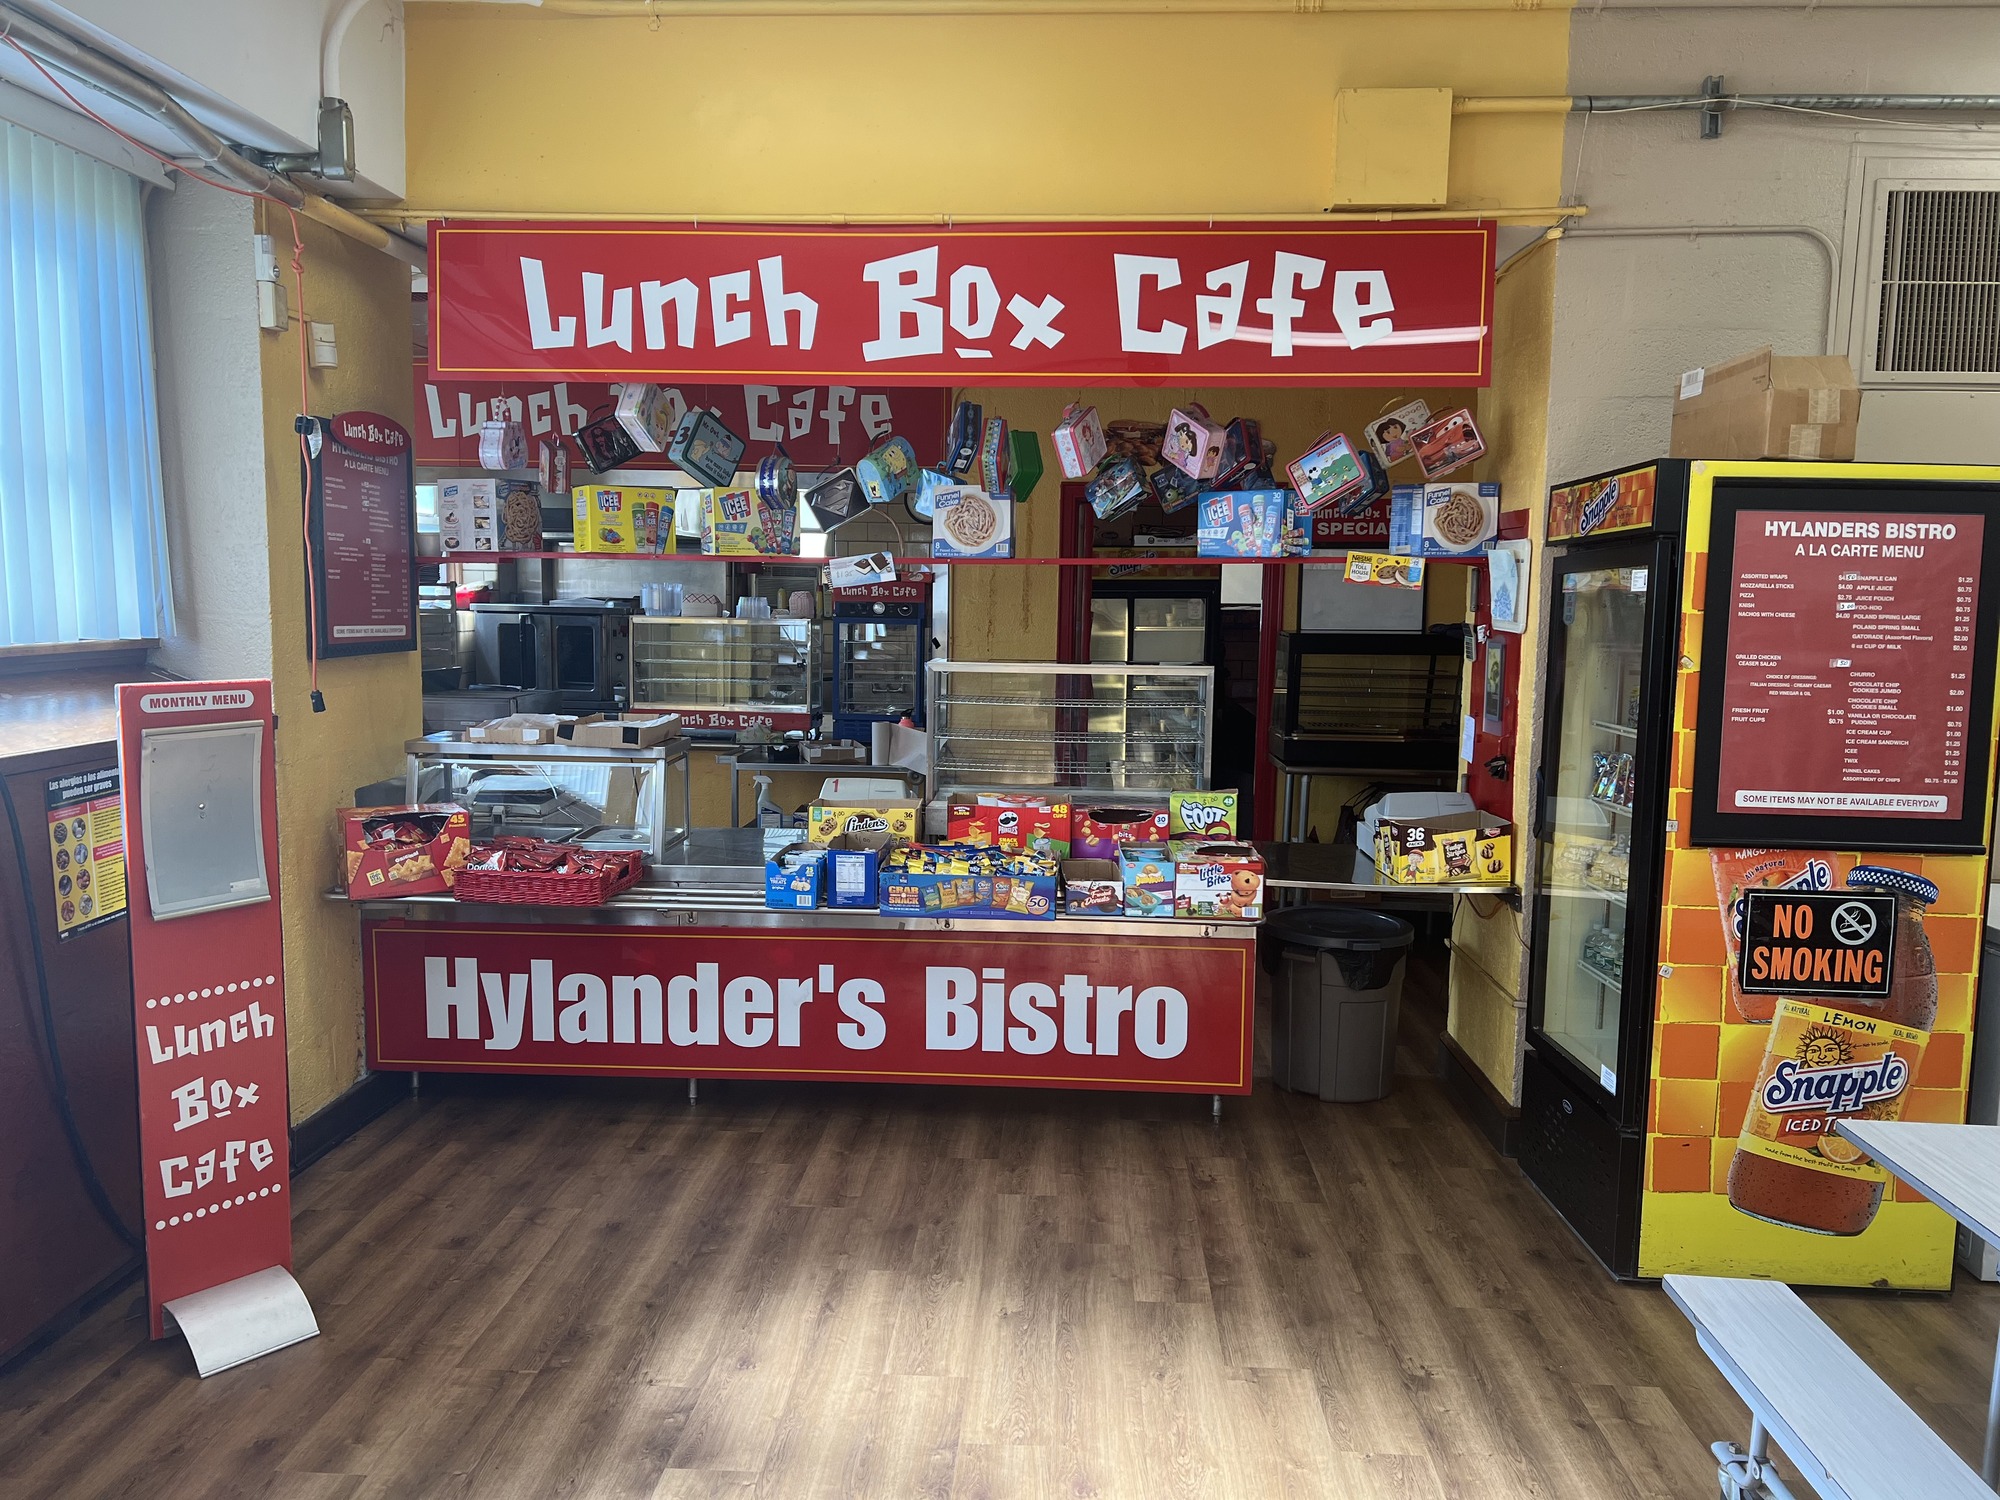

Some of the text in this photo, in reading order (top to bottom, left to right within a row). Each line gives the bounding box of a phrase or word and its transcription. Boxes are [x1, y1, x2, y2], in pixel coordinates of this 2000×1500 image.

[519, 245, 1395, 362] Lunch Box Cafe
[424, 382, 588, 439] Lunch
[743, 384, 893, 445] Cafe
[343, 420, 404, 447] Lunch Box Cafe
[674, 426, 691, 445] 3
[344, 459, 390, 476] A LA CARTE MENU
[600, 494, 620, 507] ICEE
[936, 491, 960, 502] Funnel
[1427, 488, 1451, 500] Funnel
[1429, 496, 1450, 505] Cake
[723, 495, 748, 516] ICEE
[938, 499, 959, 508] Cake
[1580, 476, 1618, 532] Snapple
[1207, 501, 1229, 521] ICEE
[1317, 522, 1389, 535] SPECIA
[1764, 520, 1956, 540] HYLANDERS BISTRO
[935, 541, 940, 549] 8
[1424, 540, 1429, 548] 8
[1794, 543, 1925, 559] A LA CARTE MENU
[841, 585, 917, 597] Lunch Box Cafe
[150, 693, 246, 709] MONTHLY MENU
[681, 713, 773, 727] nch Box Cafe
[49, 781, 59, 791] Las
[831, 778, 840, 793] 1
[1223, 797, 1234, 806] 48
[1742, 794, 1940, 808] SOME ITEMS MAY NOT BE AVAILABLE EVERYDAY
[903, 811, 914, 819] 36
[1052, 804, 1068, 814] 48
[450, 814, 465, 824] 45
[844, 815, 889, 833] Linden's
[1156, 816, 1167, 824] 30
[1180, 805, 1229, 832] FOOT
[997, 825, 1019, 836] PRINGLES
[1118, 831, 1133, 839] bits
[1406, 827, 1426, 842] 36
[1445, 842, 1465, 852] Fudge
[1446, 848, 1467, 859] Stripes
[1735, 848, 1767, 860] MANGO
[467, 862, 499, 871] Doritos
[1199, 864, 1224, 881] Little
[1206, 874, 1232, 888] Bites
[888, 885, 919, 895] GRAB
[1090, 889, 1112, 899] Frosted
[888, 896, 919, 905] SNACK
[1027, 897, 1048, 908] 50
[1085, 896, 1110, 906] Donuts
[1773, 904, 1813, 940] NO
[1751, 946, 1883, 984] SMOKING
[424, 955, 1189, 1060] Hylander's Bistro
[1790, 1005, 1810, 1016] NATURAL
[1823, 1011, 1877, 1034] LEMON
[145, 1001, 275, 1065] Lunch
[1766, 1052, 1903, 1114] Snapple
[170, 1076, 260, 1132] Box
[1785, 1117, 1822, 1133] ICED
[1765, 1146, 1779, 1155] made
[1779, 1150, 1792, 1158] from
[1792, 1153, 1803, 1161] the
[1804, 1157, 1817, 1166] best
[1818, 1159, 1833, 1169] stuff
[159, 1138, 274, 1199] Cafe
